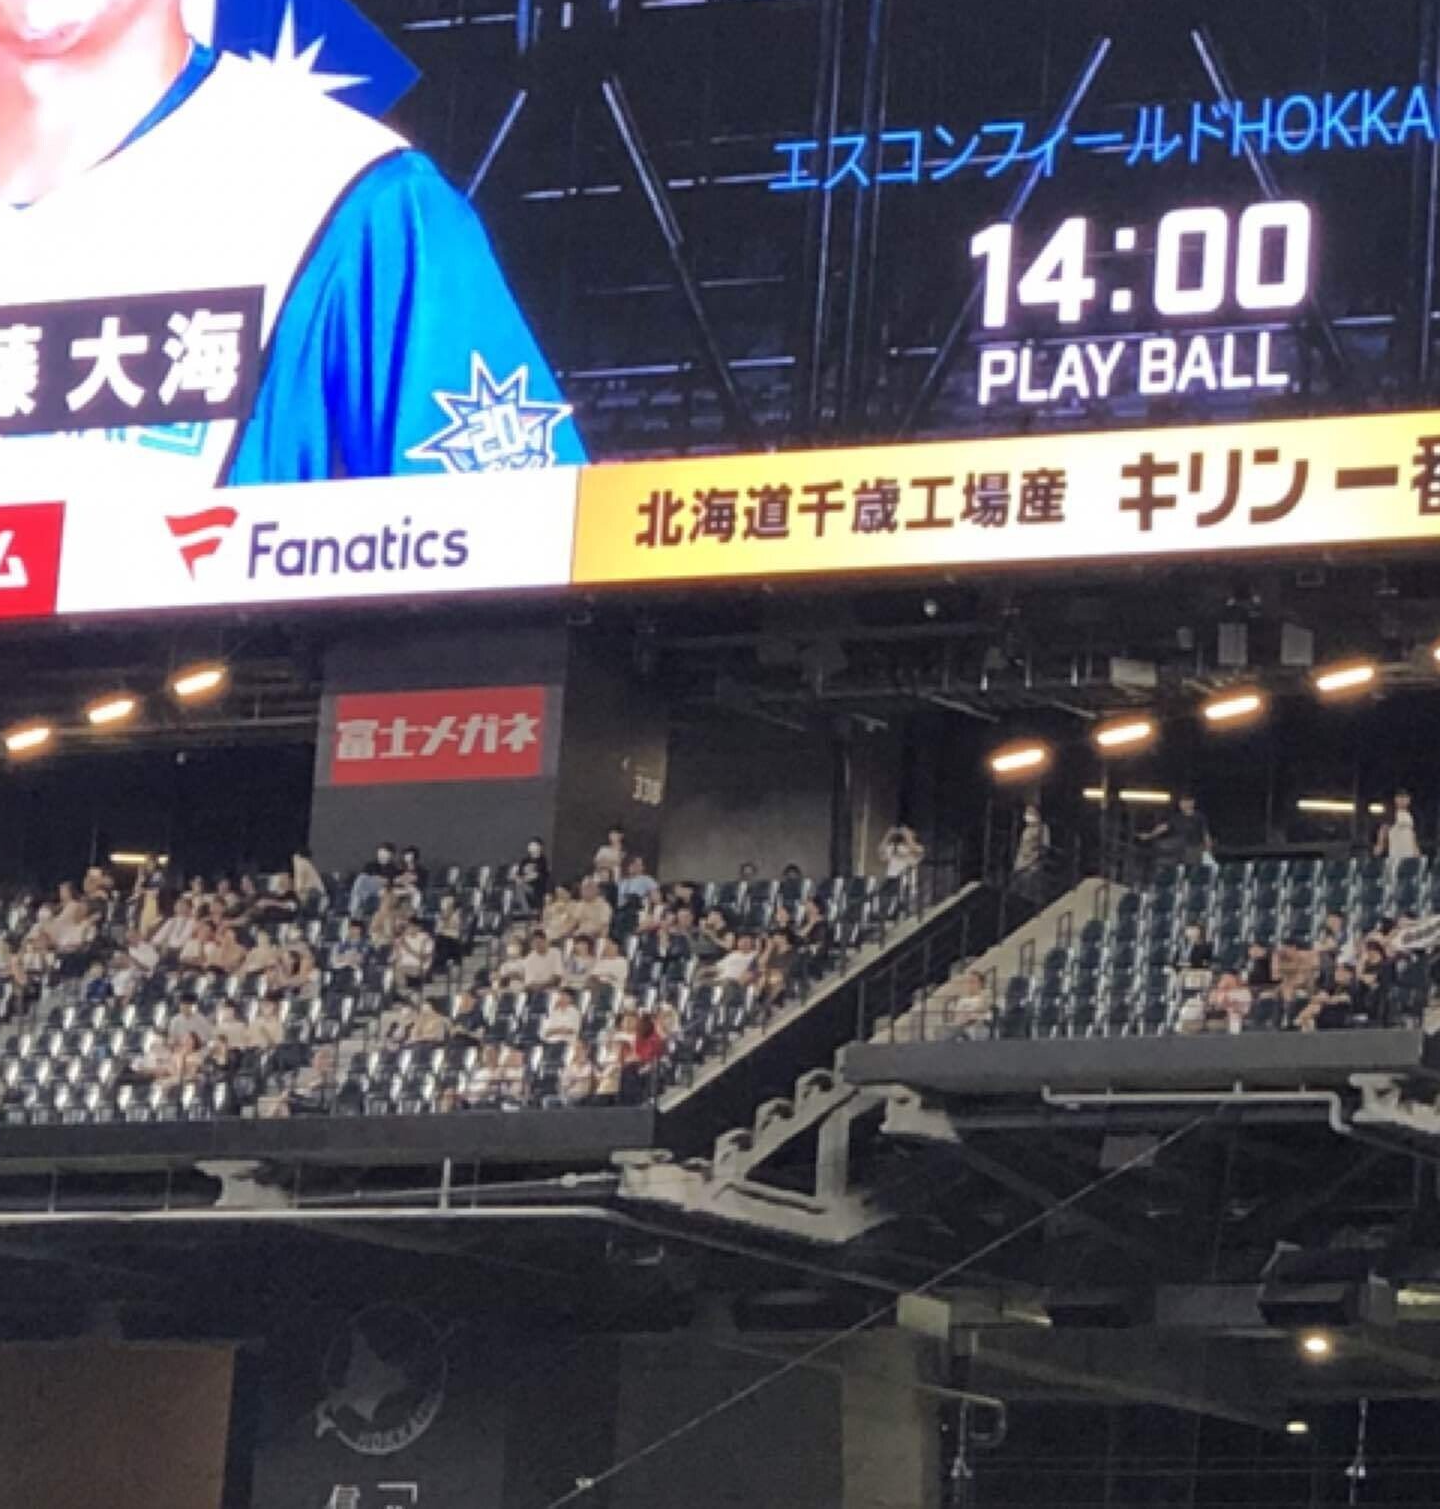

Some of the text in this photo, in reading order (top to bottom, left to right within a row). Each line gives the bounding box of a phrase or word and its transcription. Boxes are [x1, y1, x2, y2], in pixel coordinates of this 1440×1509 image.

[970, 201, 1312, 329] 14:00
[978, 331, 1289, 405] PLAY BALL
[635, 468, 1066, 549] 北海道千歳工場産
[249, 518, 468, 578] Fanatics
[336, 713, 539, 759] 富士メガネ
